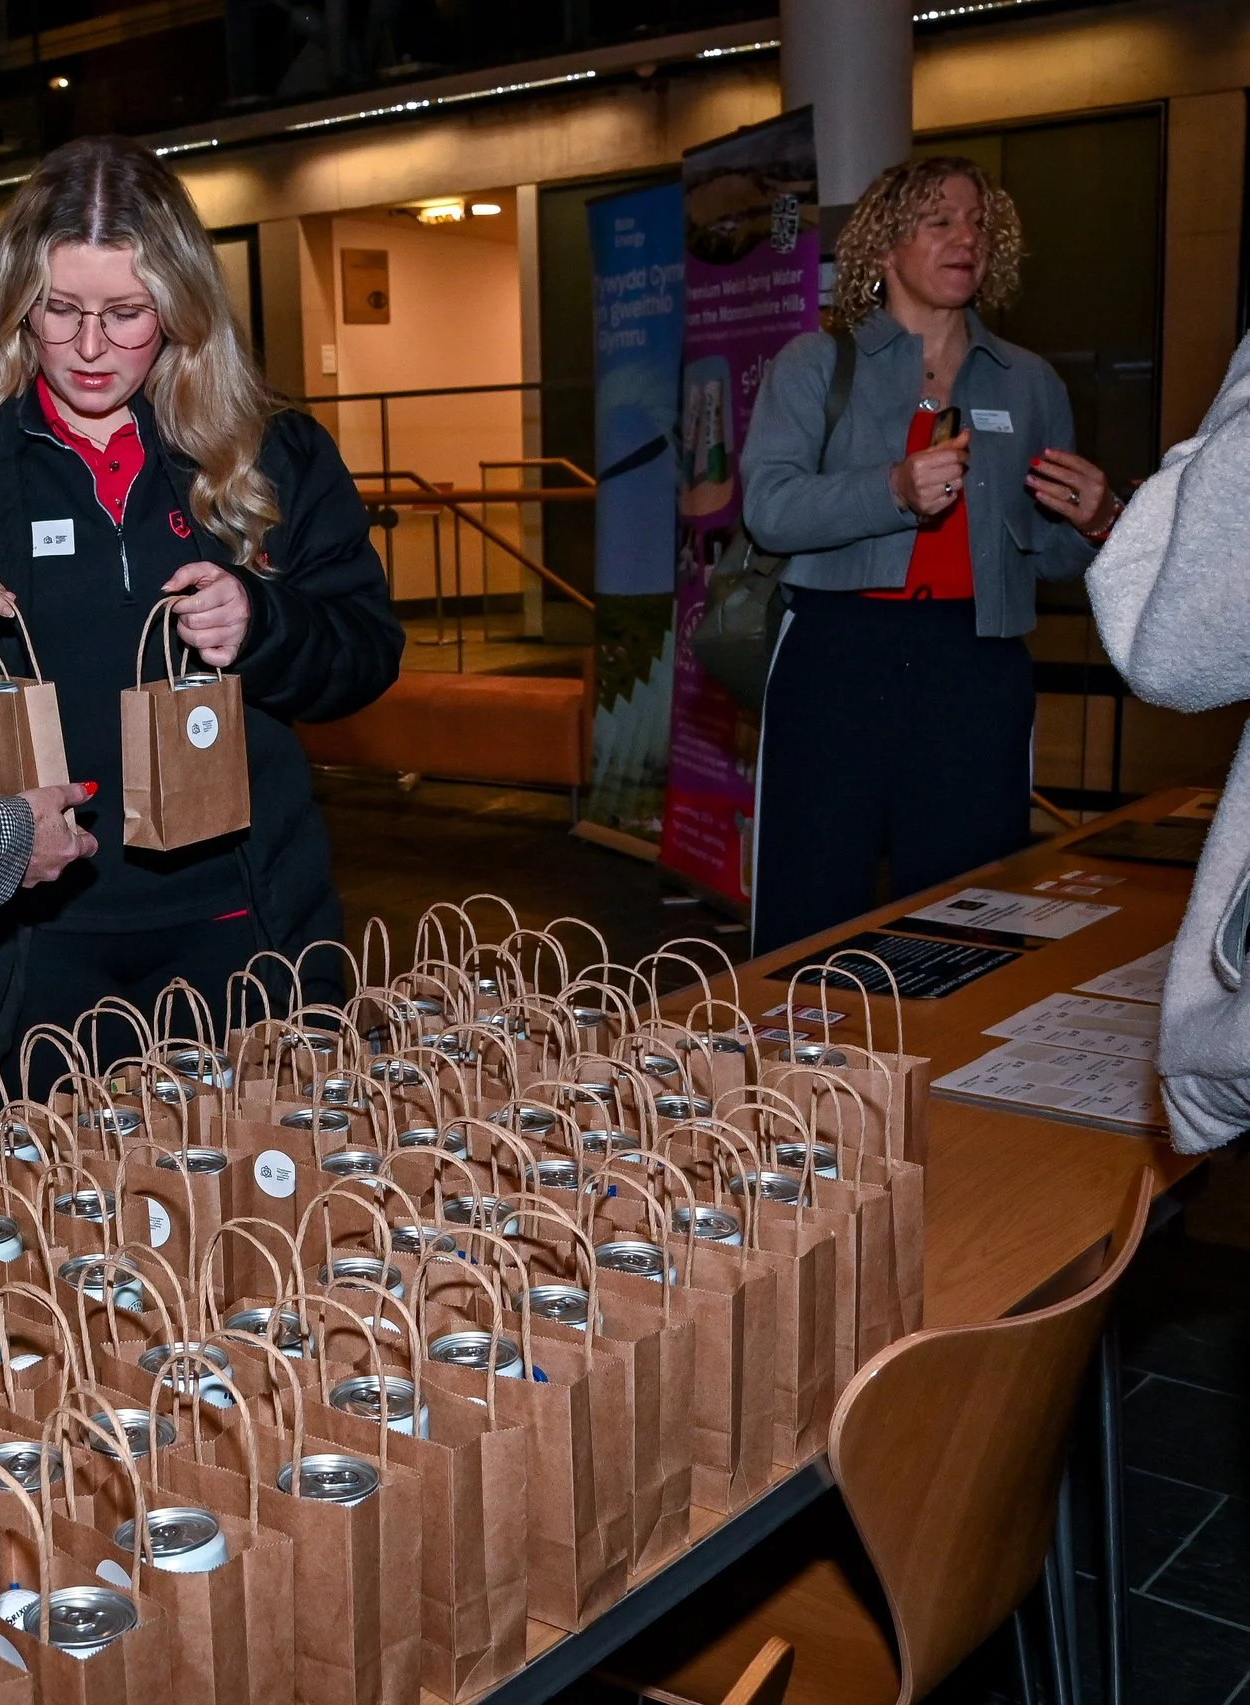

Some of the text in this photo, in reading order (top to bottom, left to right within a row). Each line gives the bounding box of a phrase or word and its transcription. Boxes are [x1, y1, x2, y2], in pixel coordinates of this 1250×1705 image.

[772, 268, 805, 287] Water
[701, 308, 718, 325] the
[782, 293, 806, 313] Hills
[5, 1601, 36, 1625] SRIXO
